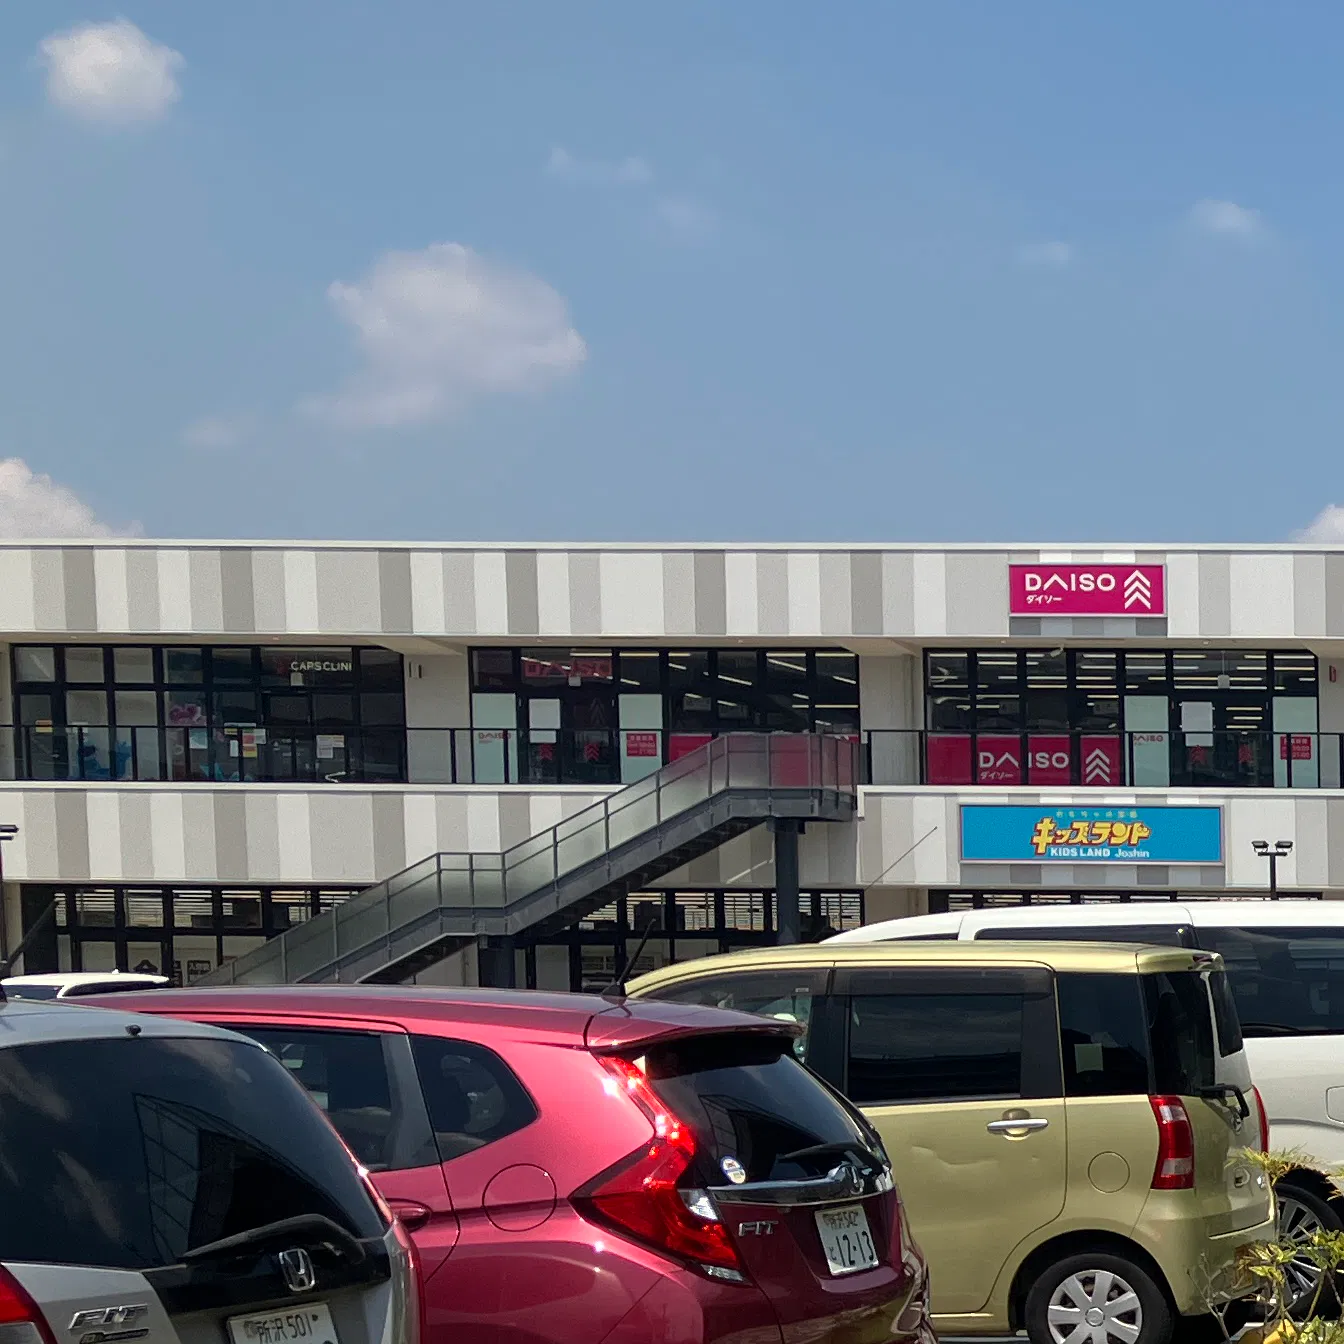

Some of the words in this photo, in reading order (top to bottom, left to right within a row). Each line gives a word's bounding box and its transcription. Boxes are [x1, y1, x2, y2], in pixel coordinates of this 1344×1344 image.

[1024, 573, 1116, 592] DAISO
[1026, 594, 1062, 605] ダイソー
[978, 751, 1070, 769] DAISO
[1031, 817, 1151, 855] キッズランド
[1050, 847, 1078, 857] KIDS
[1079, 847, 1111, 857] LAND
[1114, 848, 1150, 858] Joshin
[738, 1220, 779, 1237] FIT
[286, 1314, 313, 1340] 501
